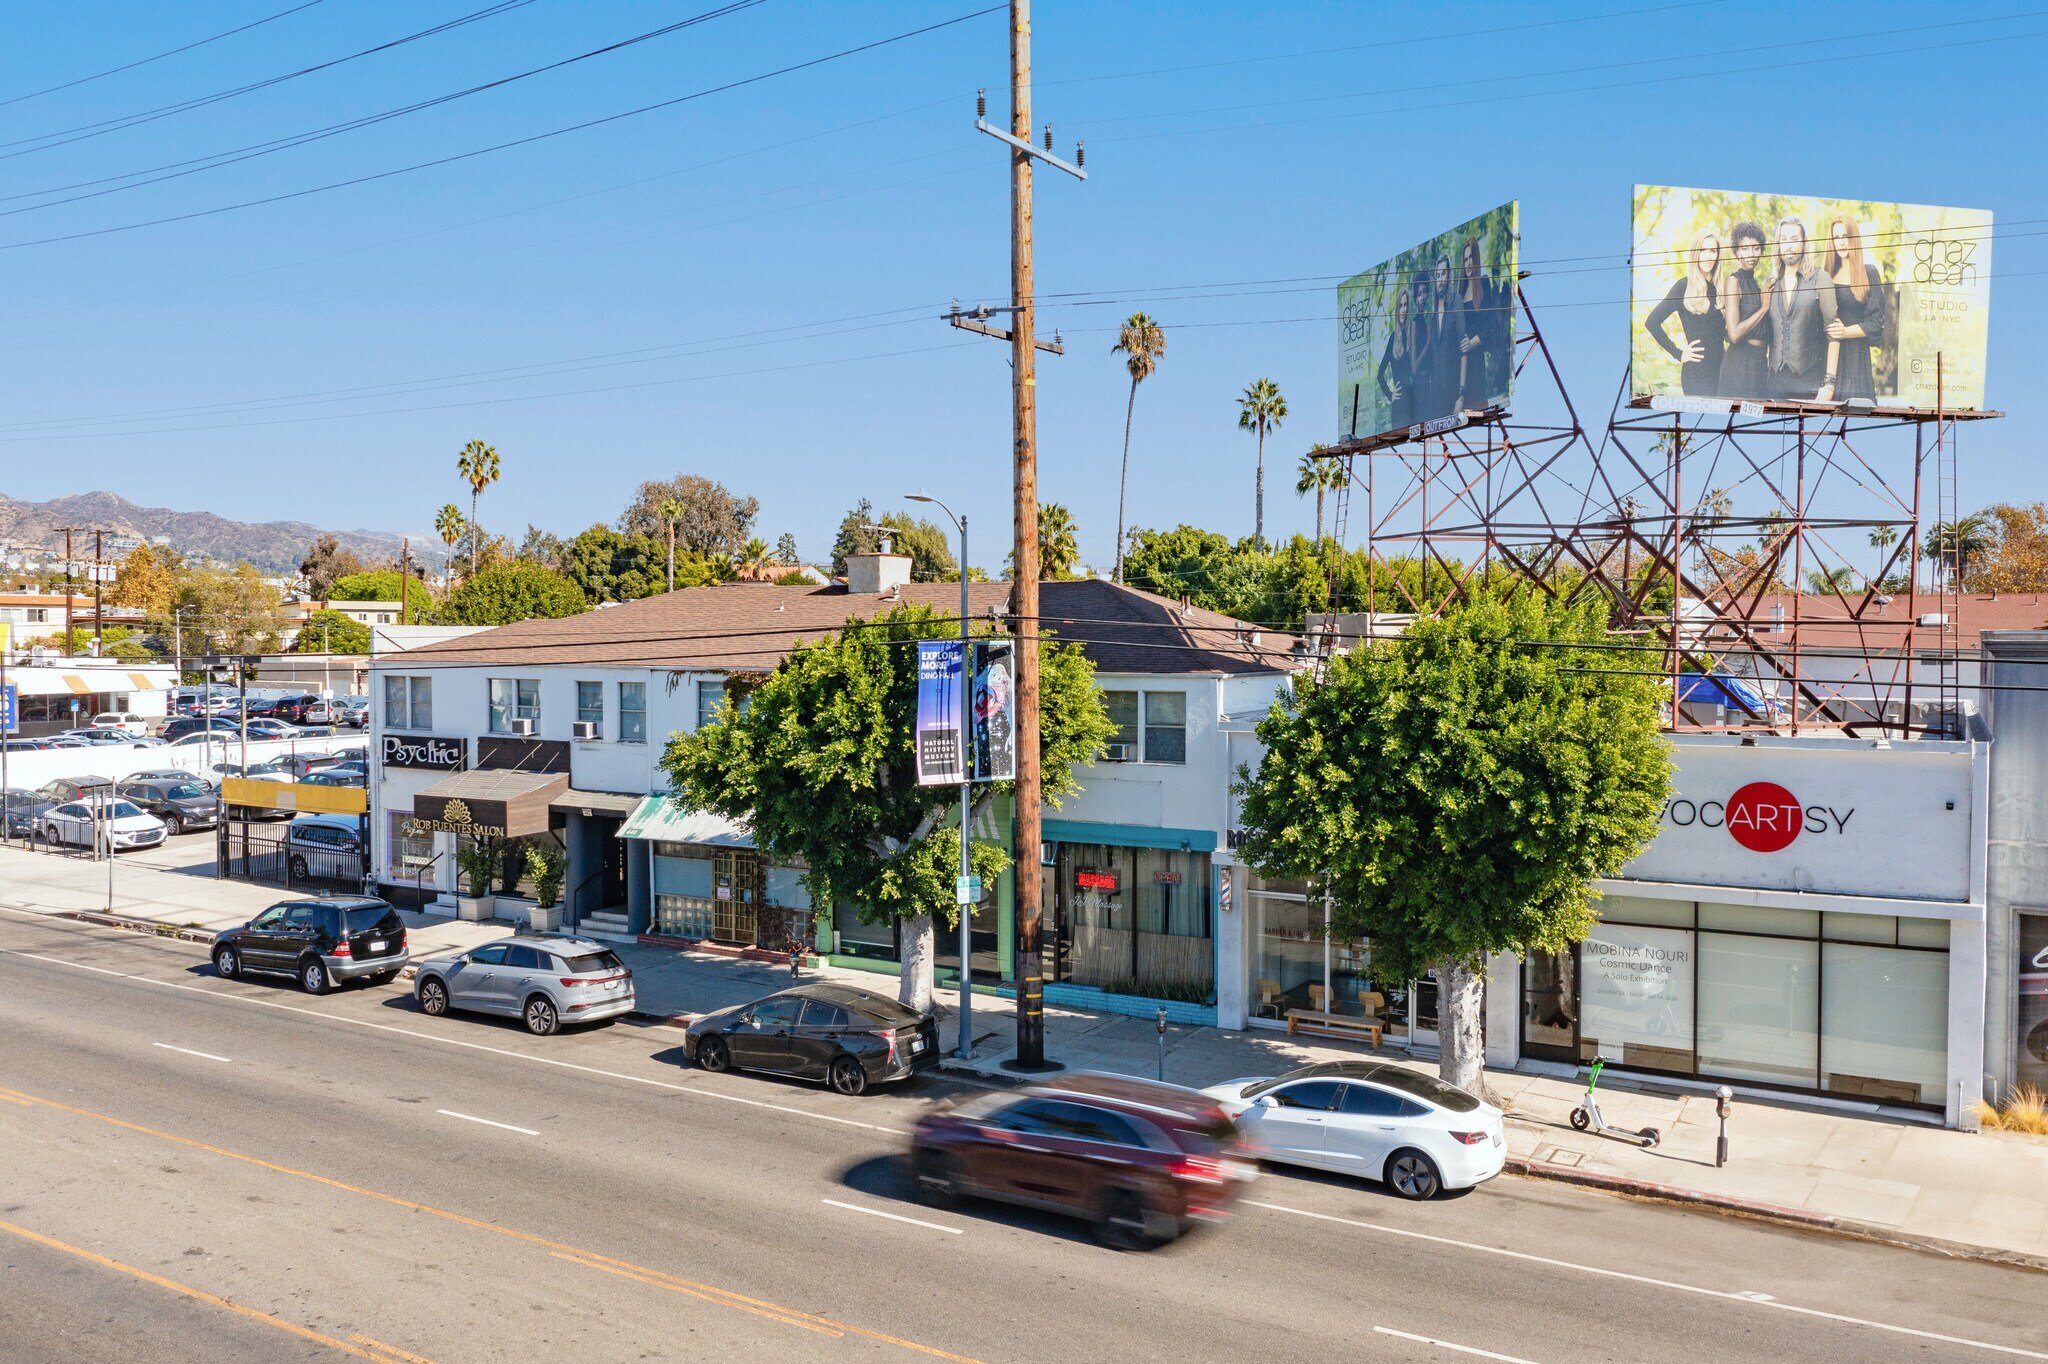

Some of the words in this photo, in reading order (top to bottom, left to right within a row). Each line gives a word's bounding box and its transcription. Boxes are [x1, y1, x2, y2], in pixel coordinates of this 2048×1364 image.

[1914, 258, 1977, 287] dean
[1921, 300, 1968, 311] STUDIO
[1346, 350, 1367, 365] STUDIO
[1915, 383, 1968, 392] chazdan.com
[1656, 400, 1728, 412] OUTFRONT
[1425, 415, 1459, 433] OUTFRON
[922, 652, 958, 660] EXPLORE
[921, 661, 946, 670] MORE
[382, 737, 460, 765] Psychic
[413, 818, 431, 830] ROB
[432, 820, 472, 834] FUENTES
[473, 823, 504, 837] SALON
[1154, 871, 1181, 883] OPEN
[1265, 927, 1287, 936] BARBER
[1586, 943, 1641, 957] MOBINA
[1645, 948, 1688, 962] NOURI
[1599, 958, 1637, 970] Cosmic
[1639, 962, 1672, 974] Dance
[1611, 972, 1628, 981] Solo
[1629, 974, 1668, 985] Exhibition
